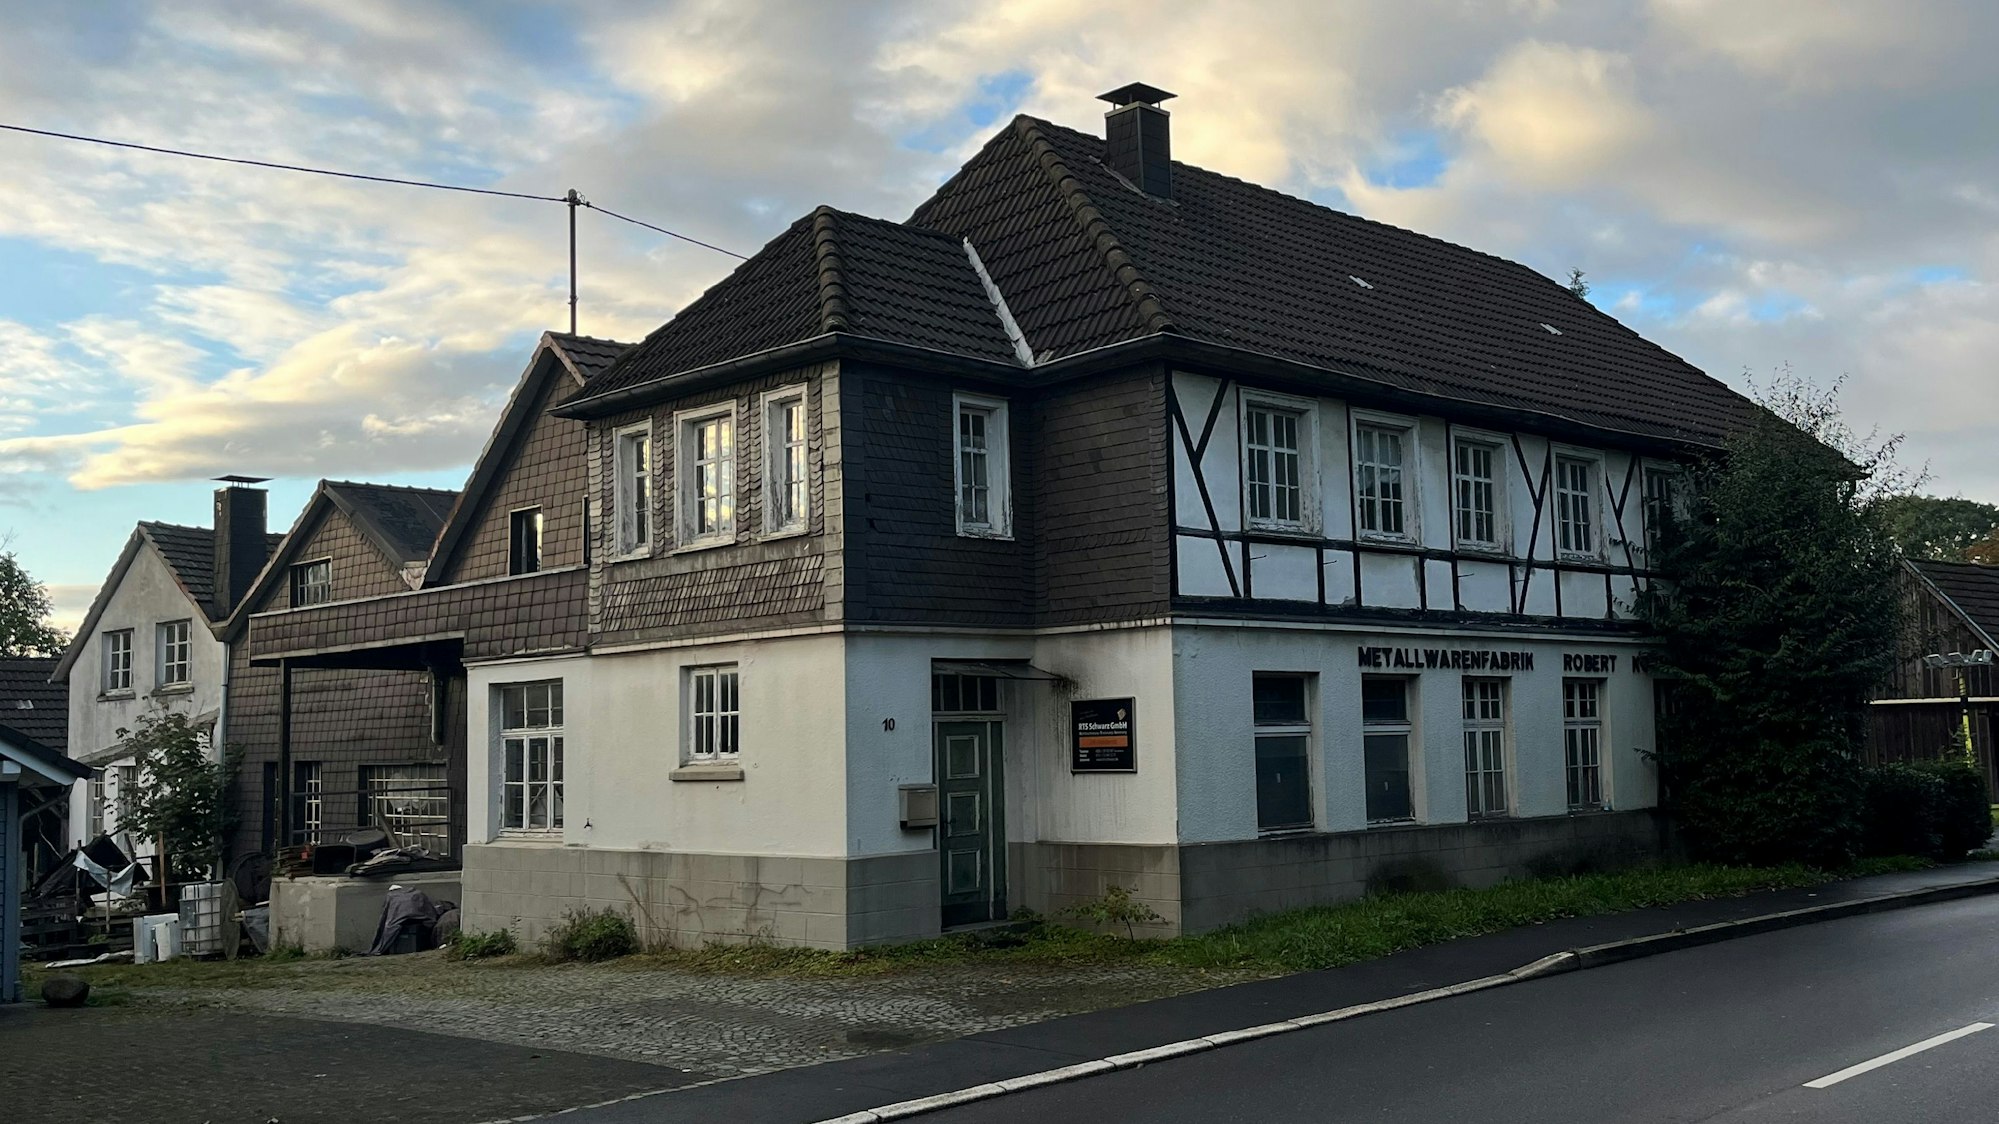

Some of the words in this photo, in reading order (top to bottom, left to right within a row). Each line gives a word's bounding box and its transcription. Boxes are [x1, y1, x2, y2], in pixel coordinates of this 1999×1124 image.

[1358, 646, 1534, 671] METALLWARENFABRIK
[1563, 653, 1617, 673] ROBERT
[882, 717, 895, 732] 10
[1089, 722, 1110, 730] Schwarz
[1110, 722, 1127, 730] GmbH
